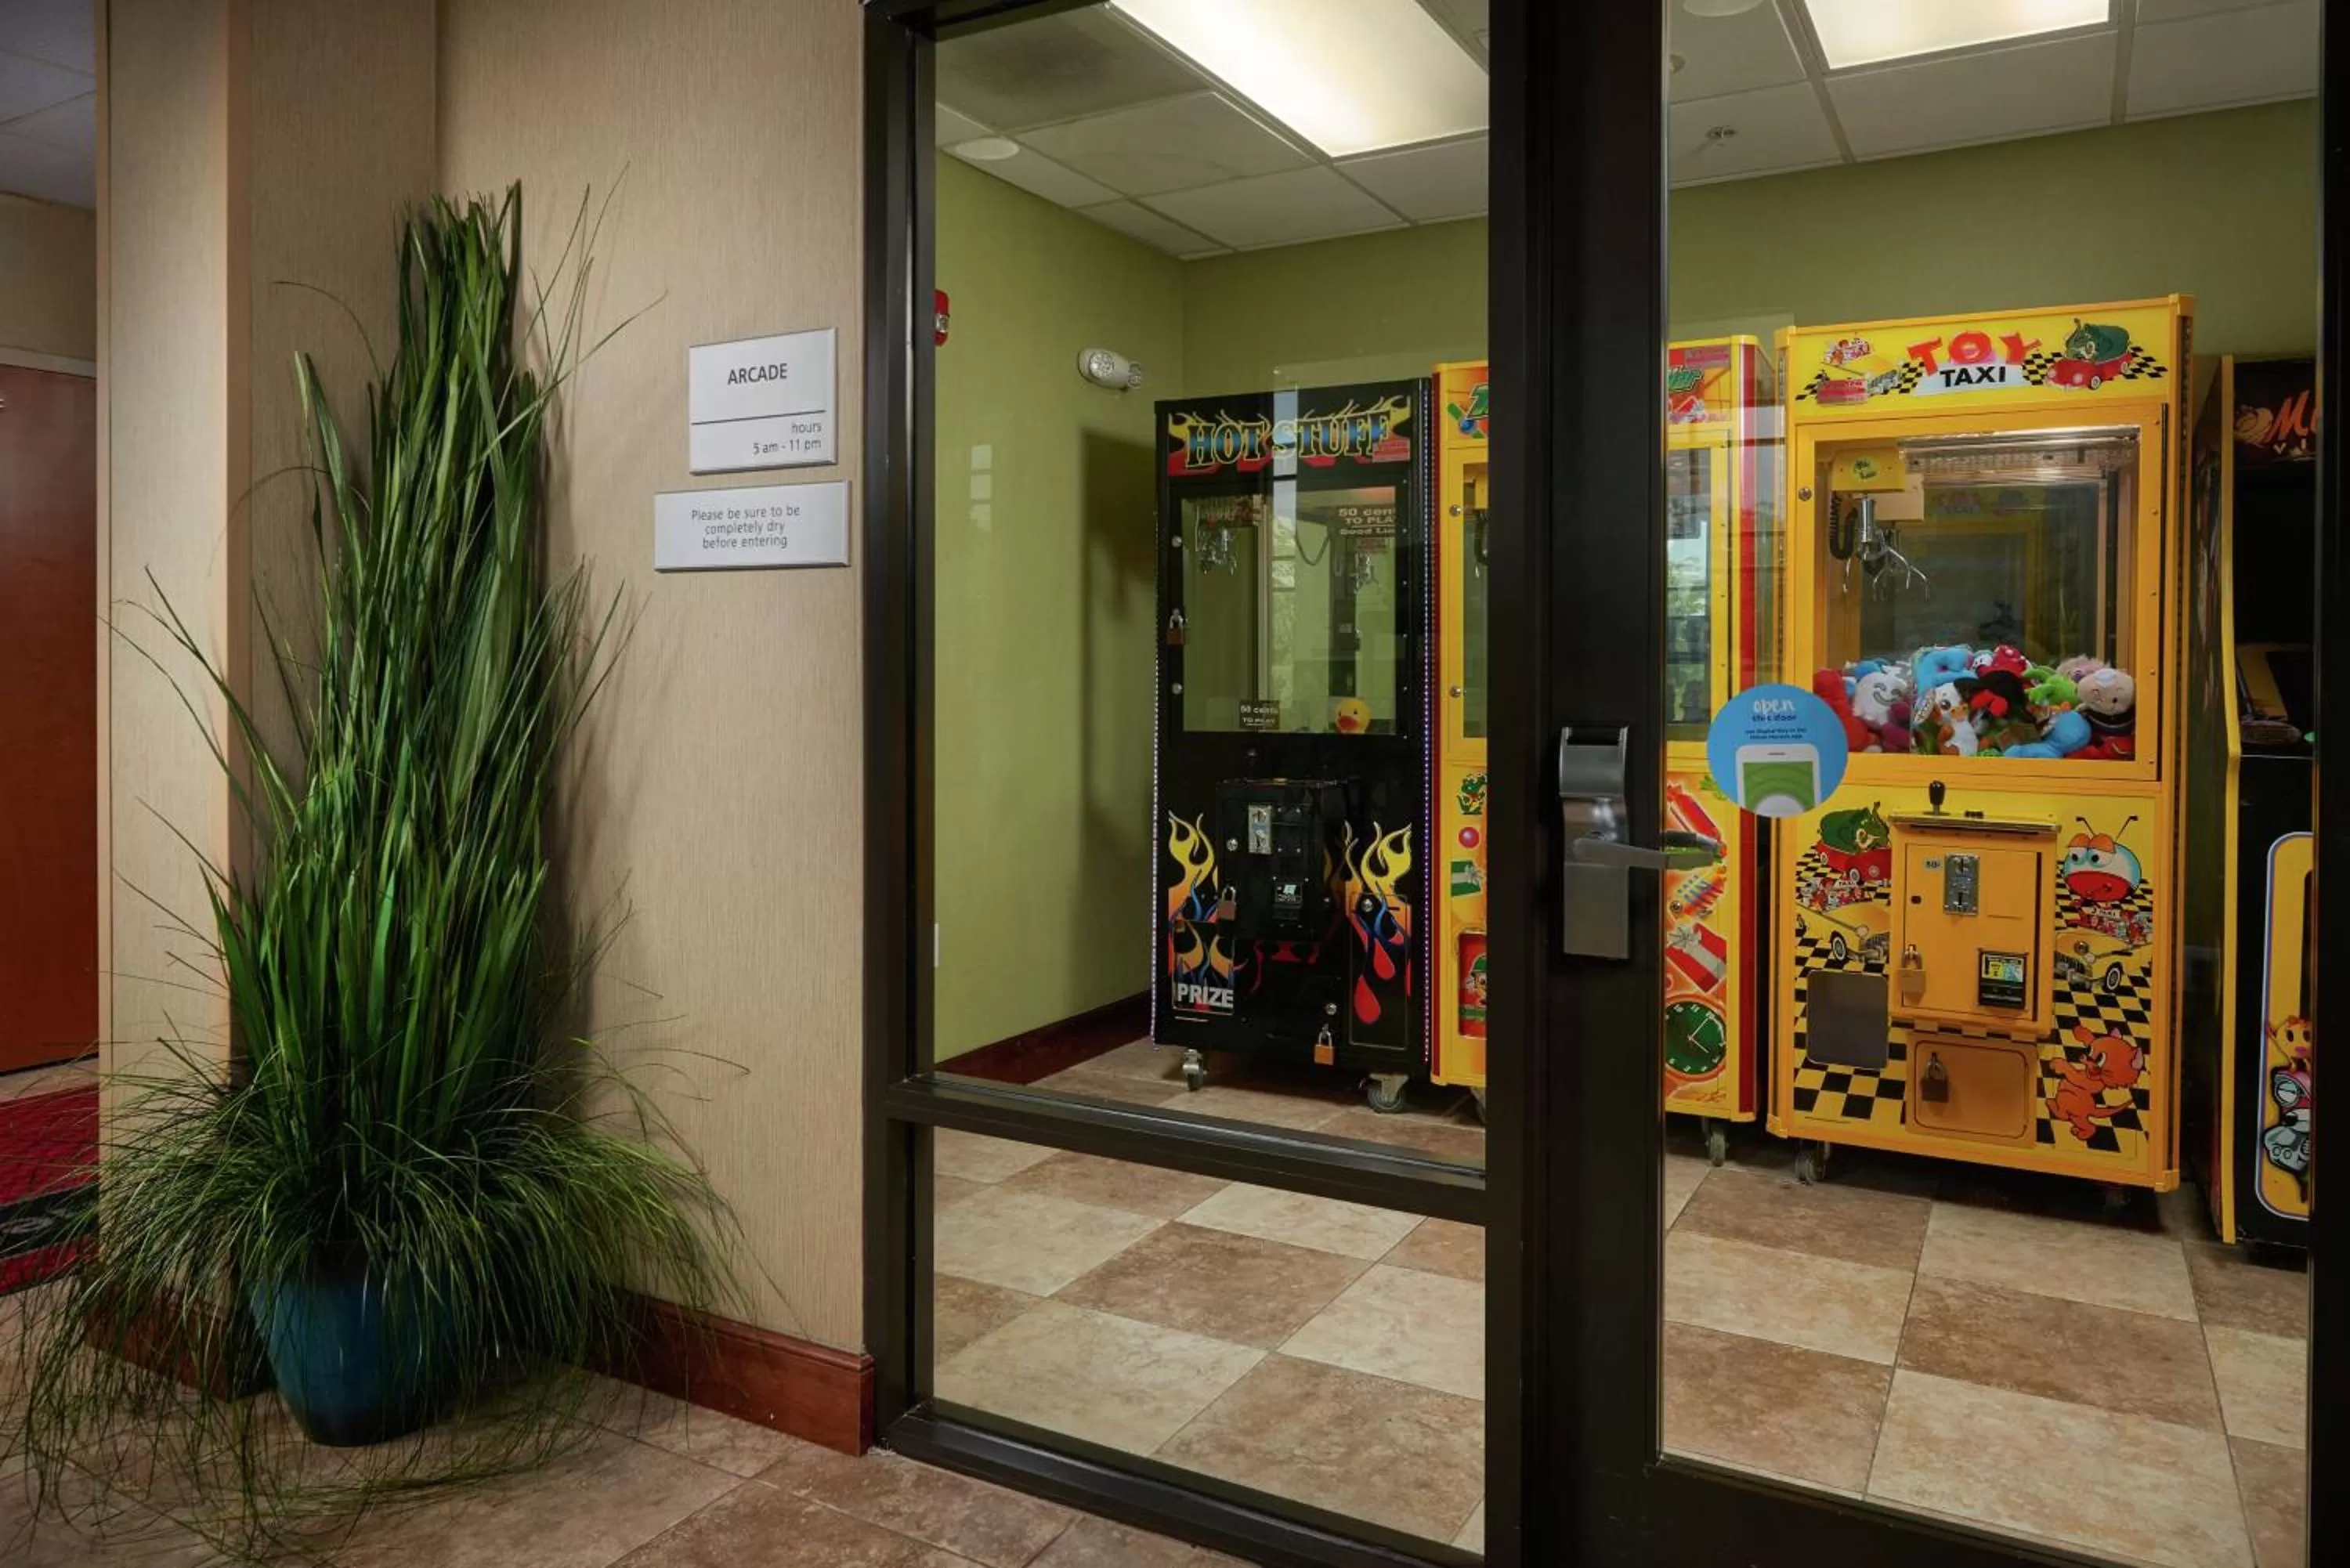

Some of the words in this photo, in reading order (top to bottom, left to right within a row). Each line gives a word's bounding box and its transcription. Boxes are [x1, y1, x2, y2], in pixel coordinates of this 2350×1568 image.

[1907, 330, 2043, 377] TOY
[728, 363, 787, 385] ARCADE
[1940, 366, 2006, 388] TAXI
[791, 421, 822, 434] hours
[753, 442, 760, 455] 5
[762, 443, 779, 454] am
[789, 439, 800, 452] 11
[804, 439, 822, 453] pm
[1185, 420, 1271, 468] HOT
[1271, 409, 1392, 459] STUFF
[691, 509, 724, 521] Please
[727, 507, 741, 519] be
[743, 508, 767, 518] sure
[771, 505, 783, 518] to
[786, 504, 801, 517] be
[705, 521, 764, 536] completely
[768, 519, 786, 534] dry
[703, 536, 738, 549] before
[741, 535, 788, 549] entering
[1753, 698, 1797, 715] open
[1177, 983, 1234, 1009] PRIZE
